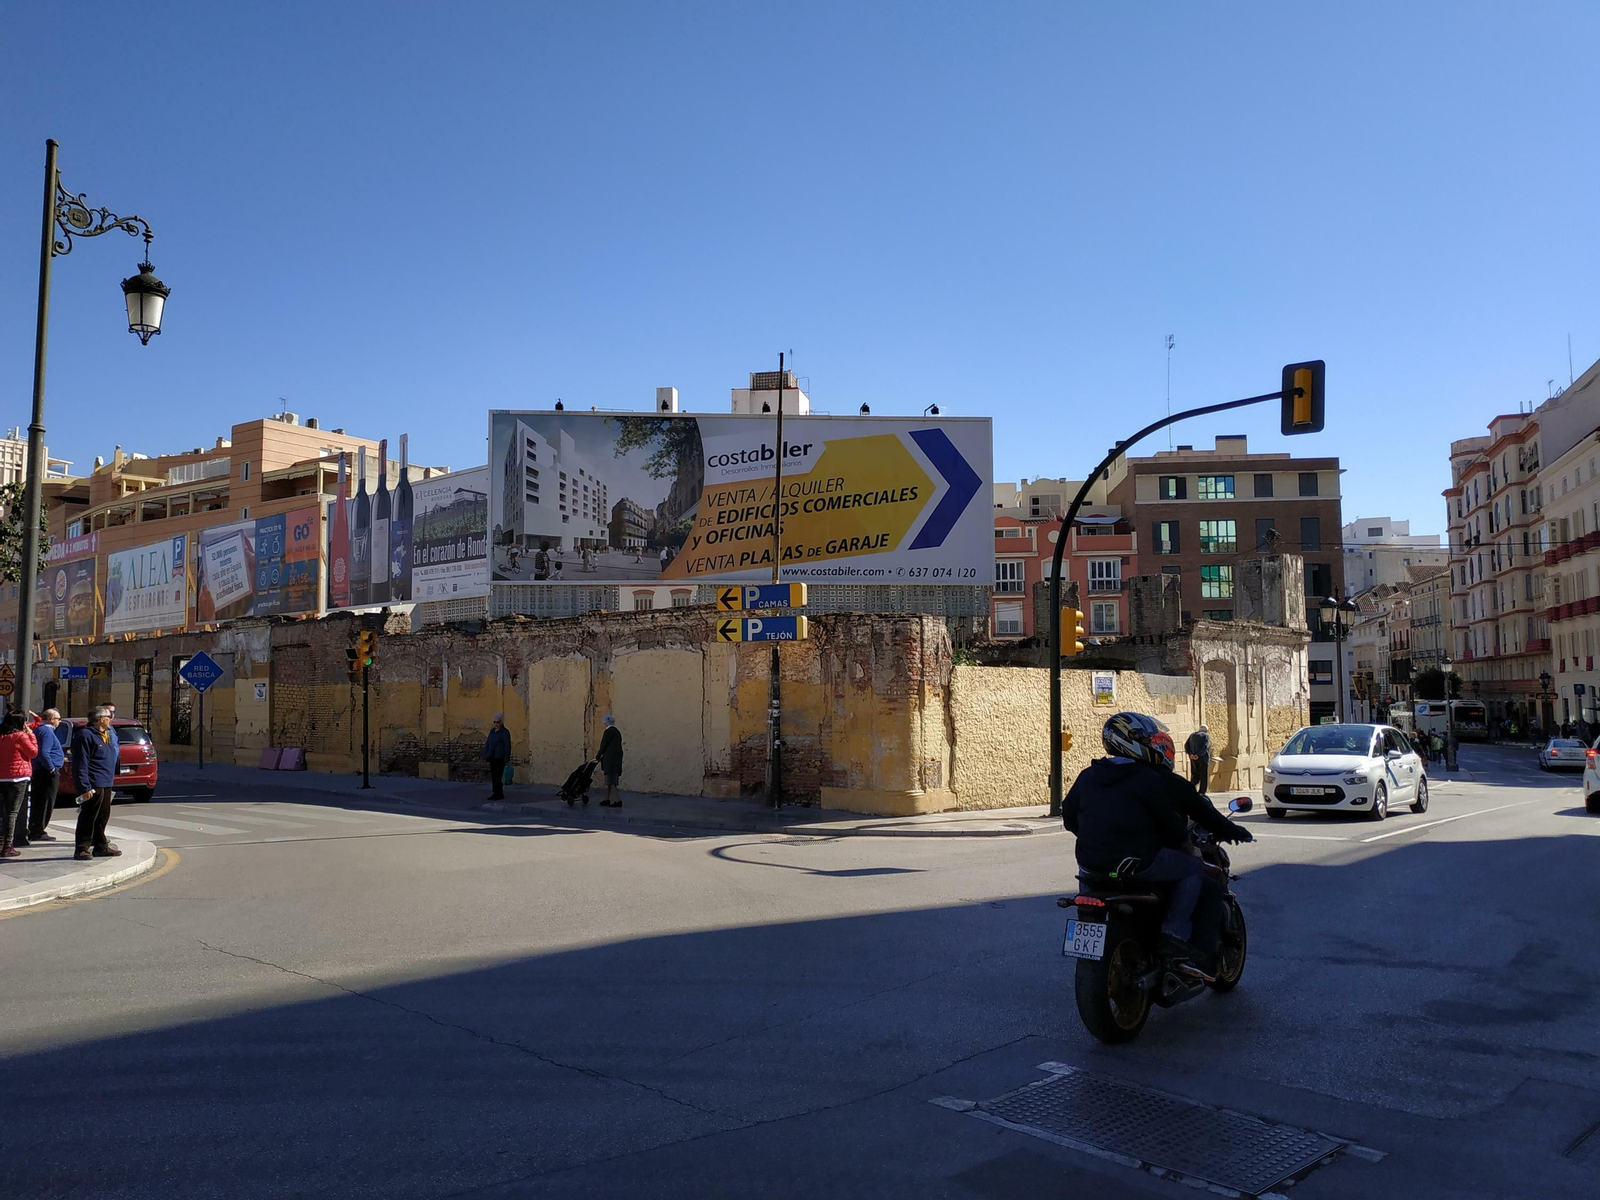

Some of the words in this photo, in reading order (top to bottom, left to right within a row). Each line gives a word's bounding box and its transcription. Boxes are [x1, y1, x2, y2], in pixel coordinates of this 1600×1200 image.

[708, 441, 812, 468] costabler
[721, 465, 759, 476] Desarrollos
[707, 488, 756, 508] VENTA
[769, 477, 845, 500] ALQUILER
[699, 517, 713, 528] DE
[717, 501, 799, 525] EDIFICIOS
[803, 486, 918, 514] COMERCIALES
[293, 523, 310, 541] GO
[691, 535, 702, 551] y
[413, 545, 421, 565] En
[422, 543, 429, 563] el
[430, 540, 456, 563] corazón
[457, 538, 466, 559] de
[467, 534, 487, 558] Rond
[686, 554, 735, 573] VENTA
[825, 533, 890, 555] GARAJE
[126, 549, 169, 591] ALEA
[782, 566, 885, 577] www.costabiler.com
[908, 567, 928, 578] 637
[932, 567, 953, 578] 074
[957, 567, 976, 578] 120
[745, 586, 760, 609] P
[758, 600, 789, 608] CAMAS
[747, 619, 763, 641] P
[765, 631, 793, 640] TEJÓN
[1075, 923, 1104, 939] 3555
[1073, 938, 1100, 953] GKF
